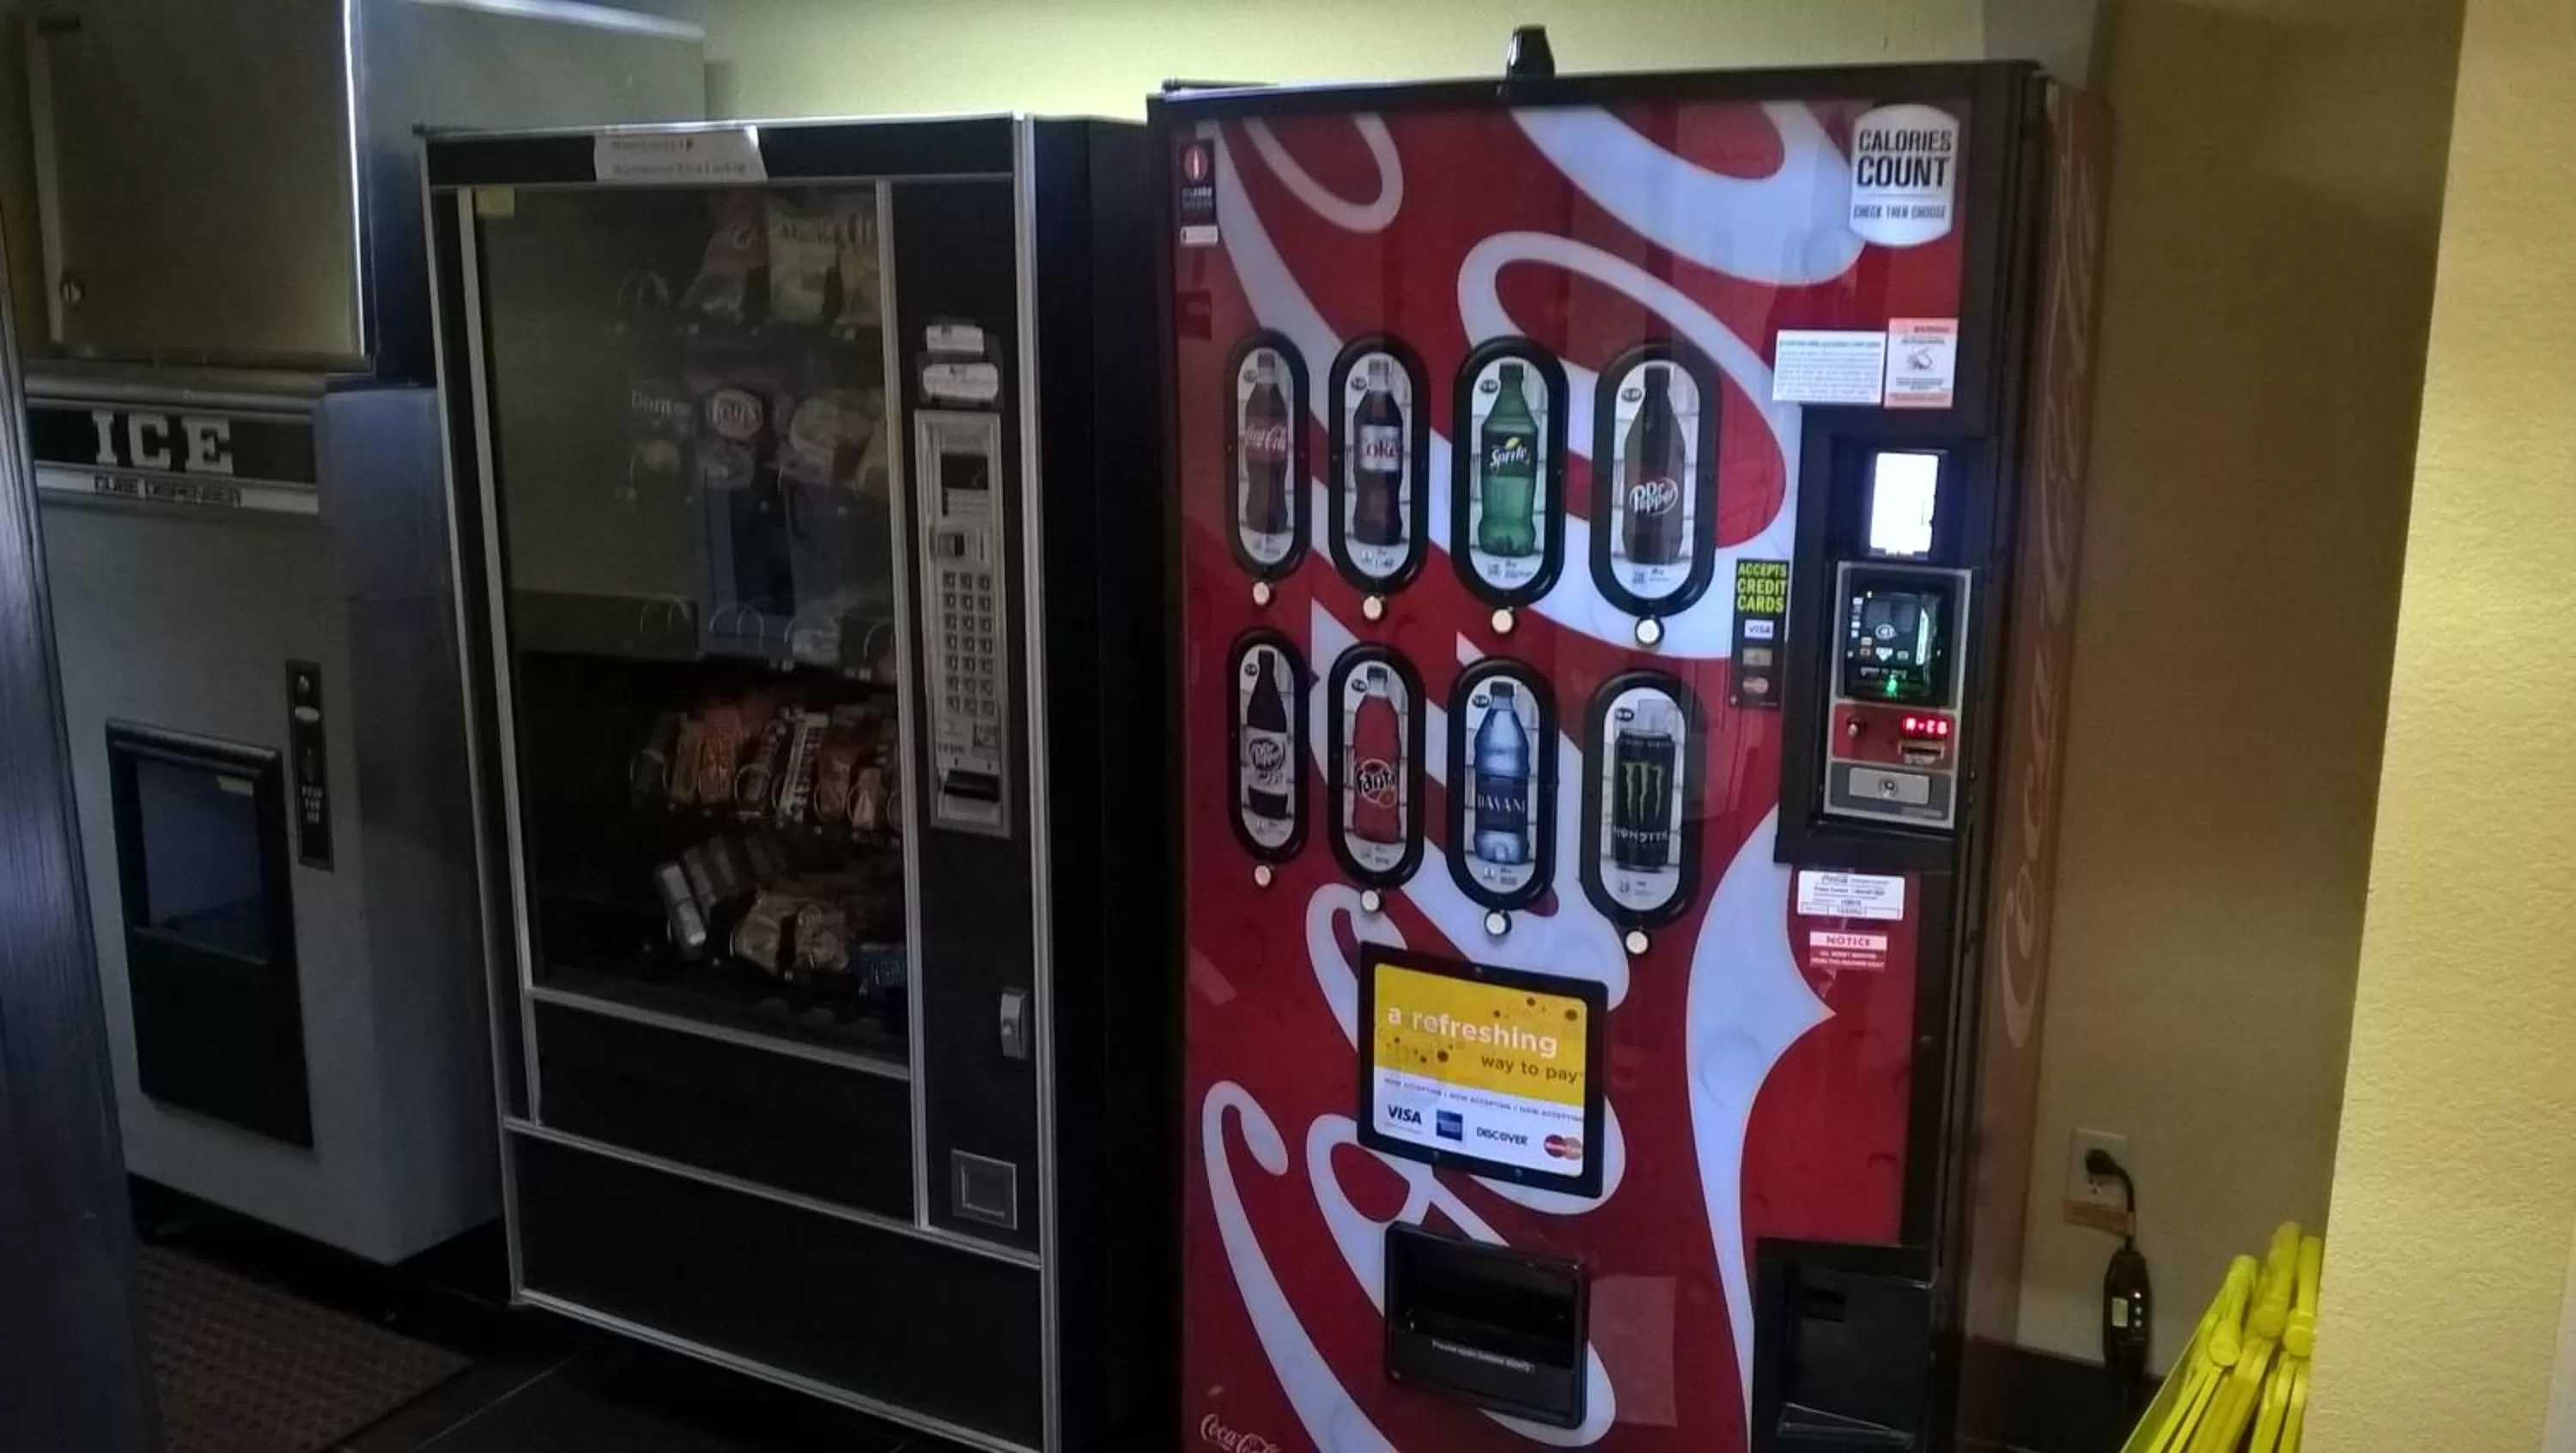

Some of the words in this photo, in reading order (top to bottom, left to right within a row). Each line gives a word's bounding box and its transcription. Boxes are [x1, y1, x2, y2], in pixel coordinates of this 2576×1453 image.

[1859, 130, 1953, 152] CALORIES
[1857, 155, 1951, 187] COUNT
[1853, 205, 1882, 219] CHECK
[1886, 205, 1909, 220] THEN
[1911, 205, 1946, 220] CHOOSE
[92, 410, 234, 474] ICE
[1490, 445, 1528, 471] Sprite
[1738, 562, 1787, 578] ACCEPTS
[1737, 578, 1787, 595] CREDIT
[1737, 595, 1785, 613] CARDS
[1826, 935, 1871, 946] NOTICE
[1388, 1006, 1402, 1026] a
[1413, 1011, 1558, 1059] refreshing
[1480, 1055, 1515, 1075] way
[1521, 1061, 1540, 1076] to
[1546, 1067, 1578, 1085] pay
[1388, 1104, 1423, 1125] VISA
[1476, 1126, 1528, 1147] DISCOVER
